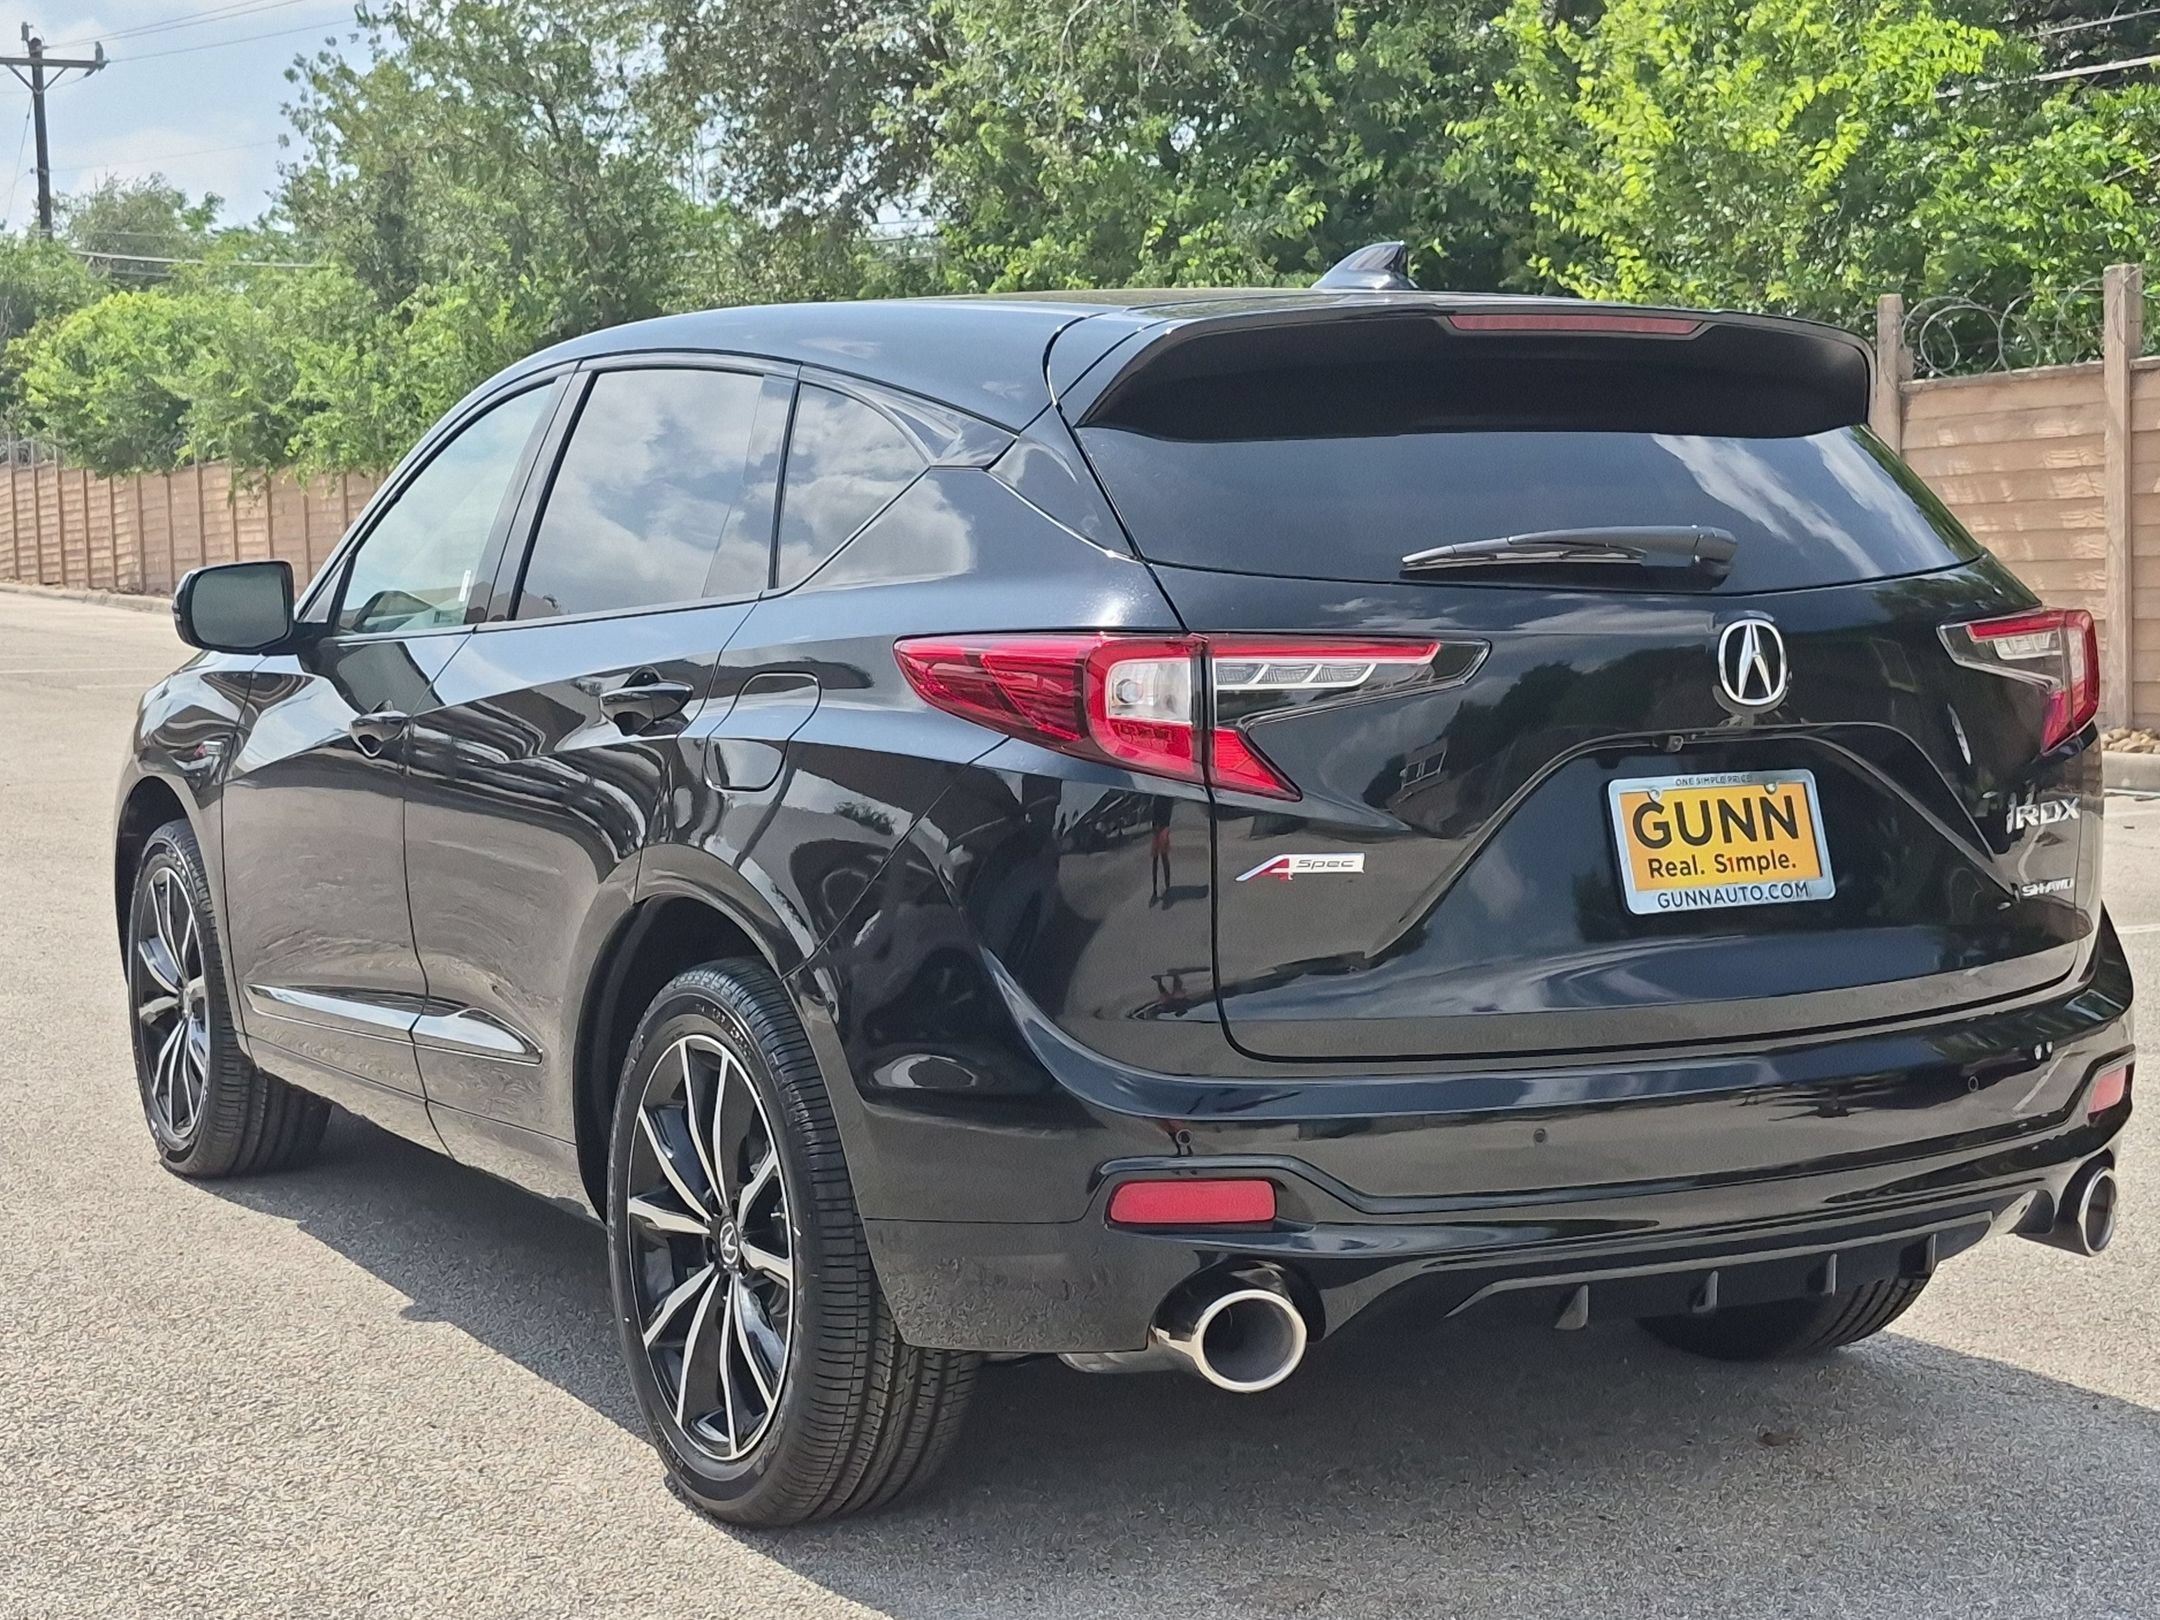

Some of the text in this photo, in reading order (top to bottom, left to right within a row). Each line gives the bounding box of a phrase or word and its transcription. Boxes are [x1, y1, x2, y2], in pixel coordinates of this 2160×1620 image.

[1675, 774, 1753, 787] ONE SIMPLE PRICE
[1632, 795, 1800, 849] GUNN
[2016, 797, 2080, 830] RDX
[1648, 854, 1705, 879] Real.
[1657, 881, 1809, 909] GUNNAUTO.COM
